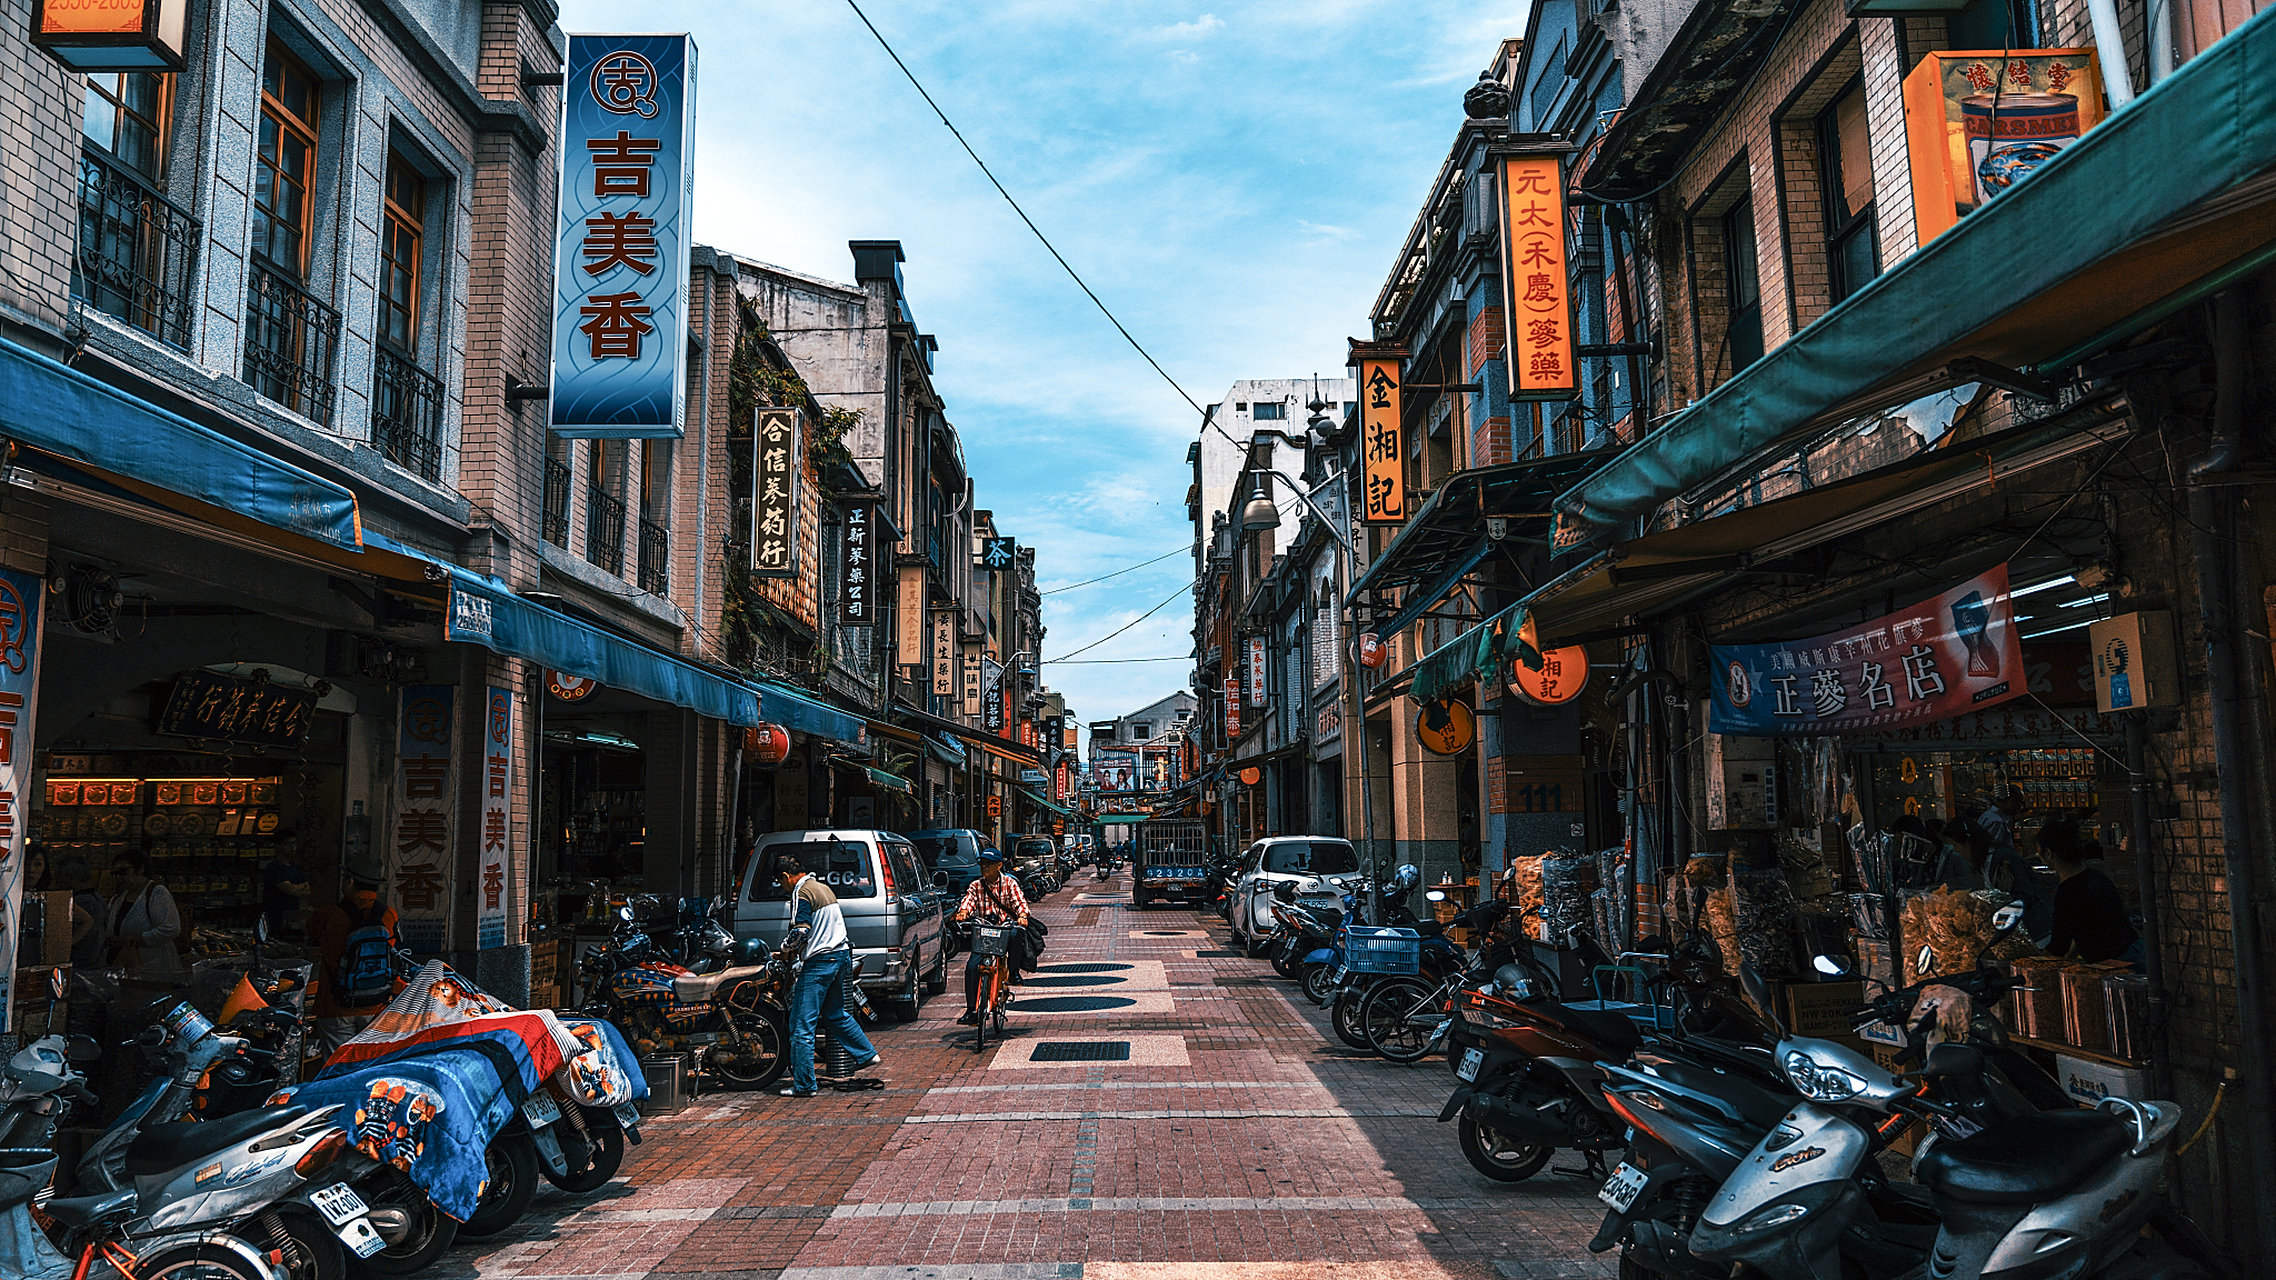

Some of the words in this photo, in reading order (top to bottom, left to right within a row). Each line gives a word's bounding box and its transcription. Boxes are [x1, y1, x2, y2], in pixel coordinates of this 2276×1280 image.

[1965, 114, 2077, 136] CARSMEX
[578, 130, 661, 360] 吉美香
[1365, 365, 1402, 517] 金湘記
[985, 540, 1013, 568] 茶
[937, 612, 949, 693] 黃長生藥行
[1769, 644, 1945, 718] 正蔘名店
[1227, 686, 1240, 731] 怡和泰
[395, 753, 449, 909] 吉美香
[483, 751, 509, 910] 吉美香
[1519, 784, 1561, 812] 111
[1802, 1010, 1819, 1019] NW
